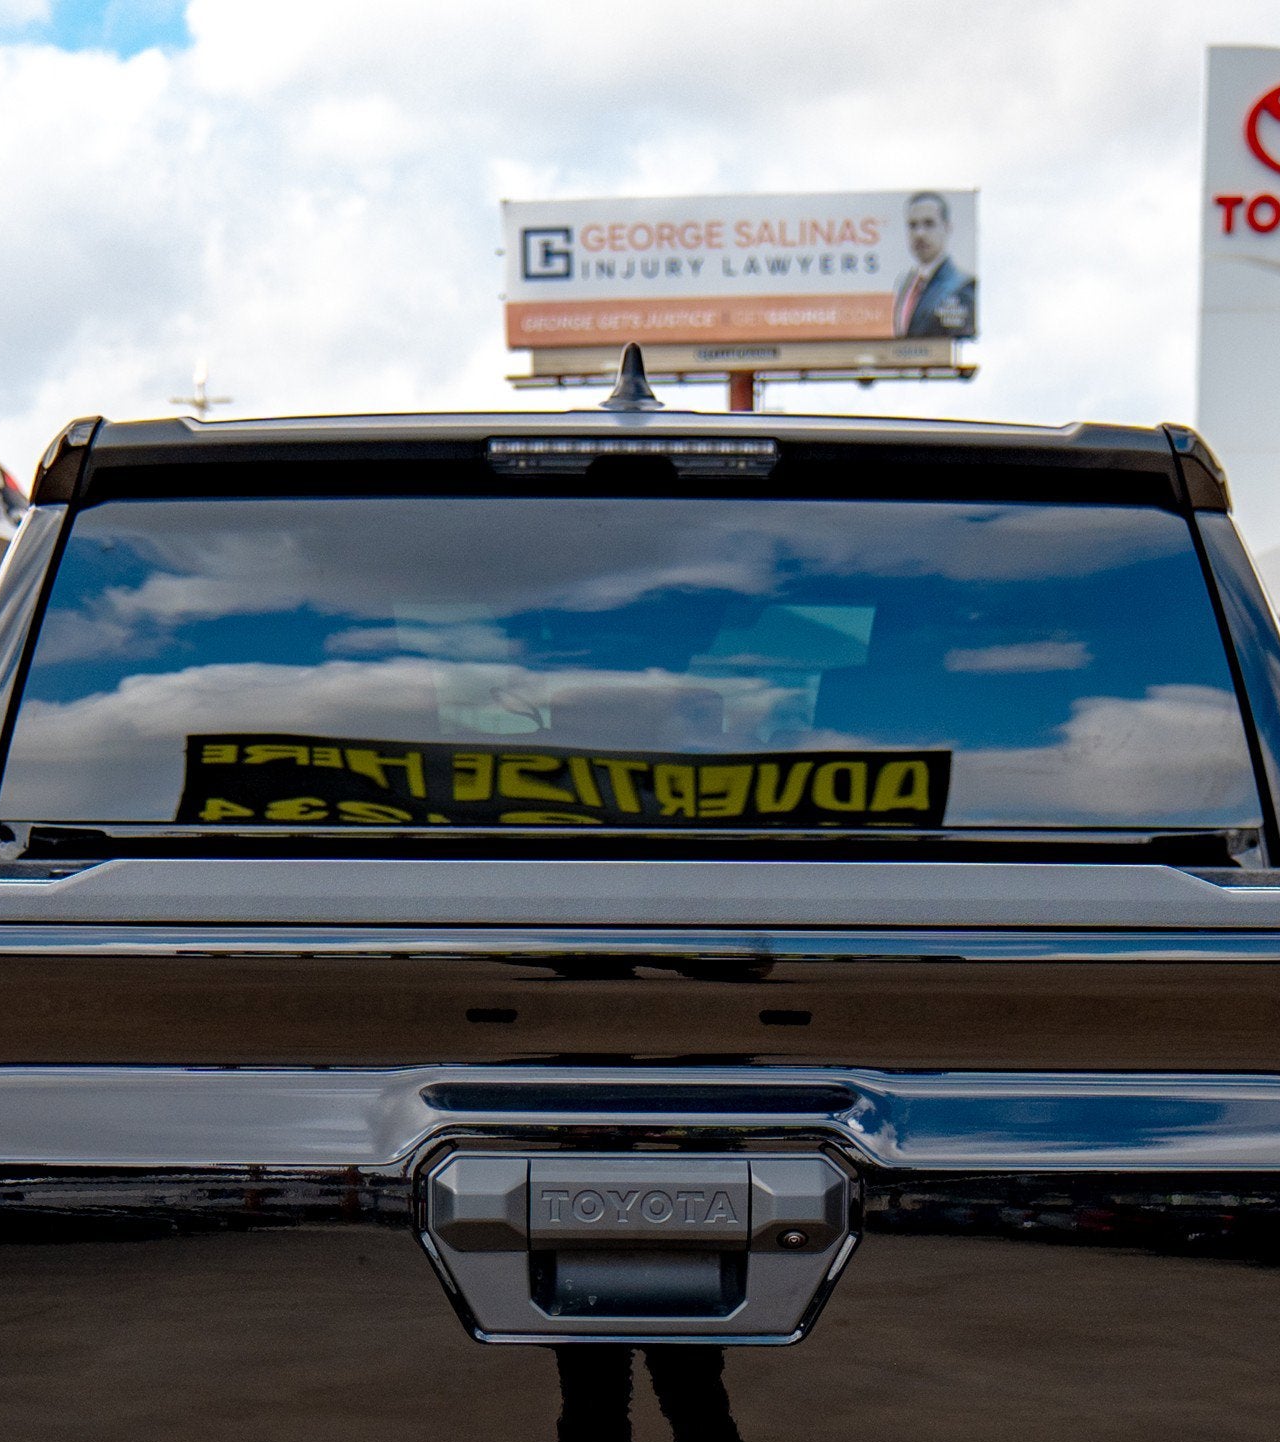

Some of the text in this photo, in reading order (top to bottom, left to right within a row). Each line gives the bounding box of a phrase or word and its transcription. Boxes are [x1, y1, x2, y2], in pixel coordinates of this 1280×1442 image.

[579, 216, 882, 253] GEORGE SALINAS
[581, 252, 881, 281] INJURY LAWYERS
[541, 1188, 739, 1224] TOYOTA
